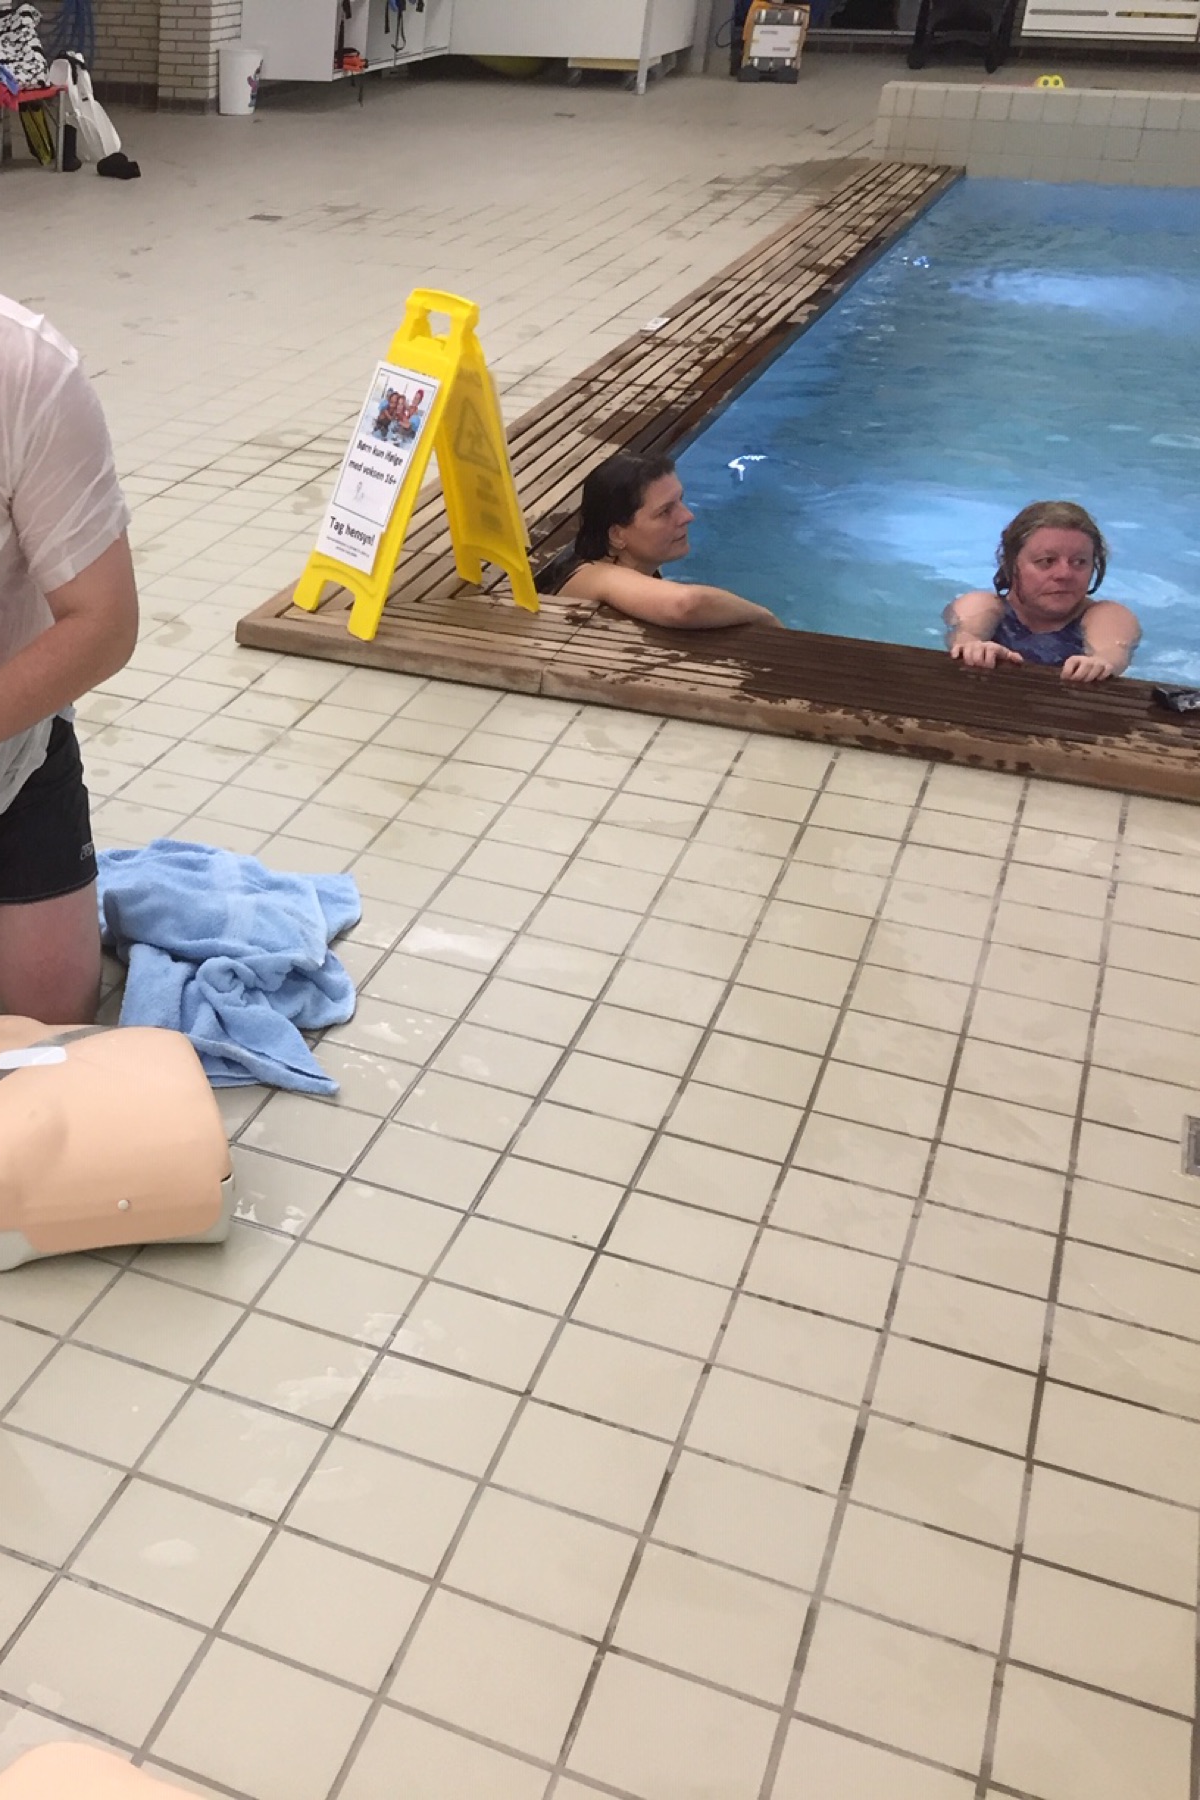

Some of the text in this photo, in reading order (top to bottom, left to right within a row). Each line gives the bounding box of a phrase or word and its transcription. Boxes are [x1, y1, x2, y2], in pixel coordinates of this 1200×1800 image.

[372, 446, 385, 459] kun
[349, 460, 364, 472] med
[330, 516, 375, 546] Tag hensyn!
